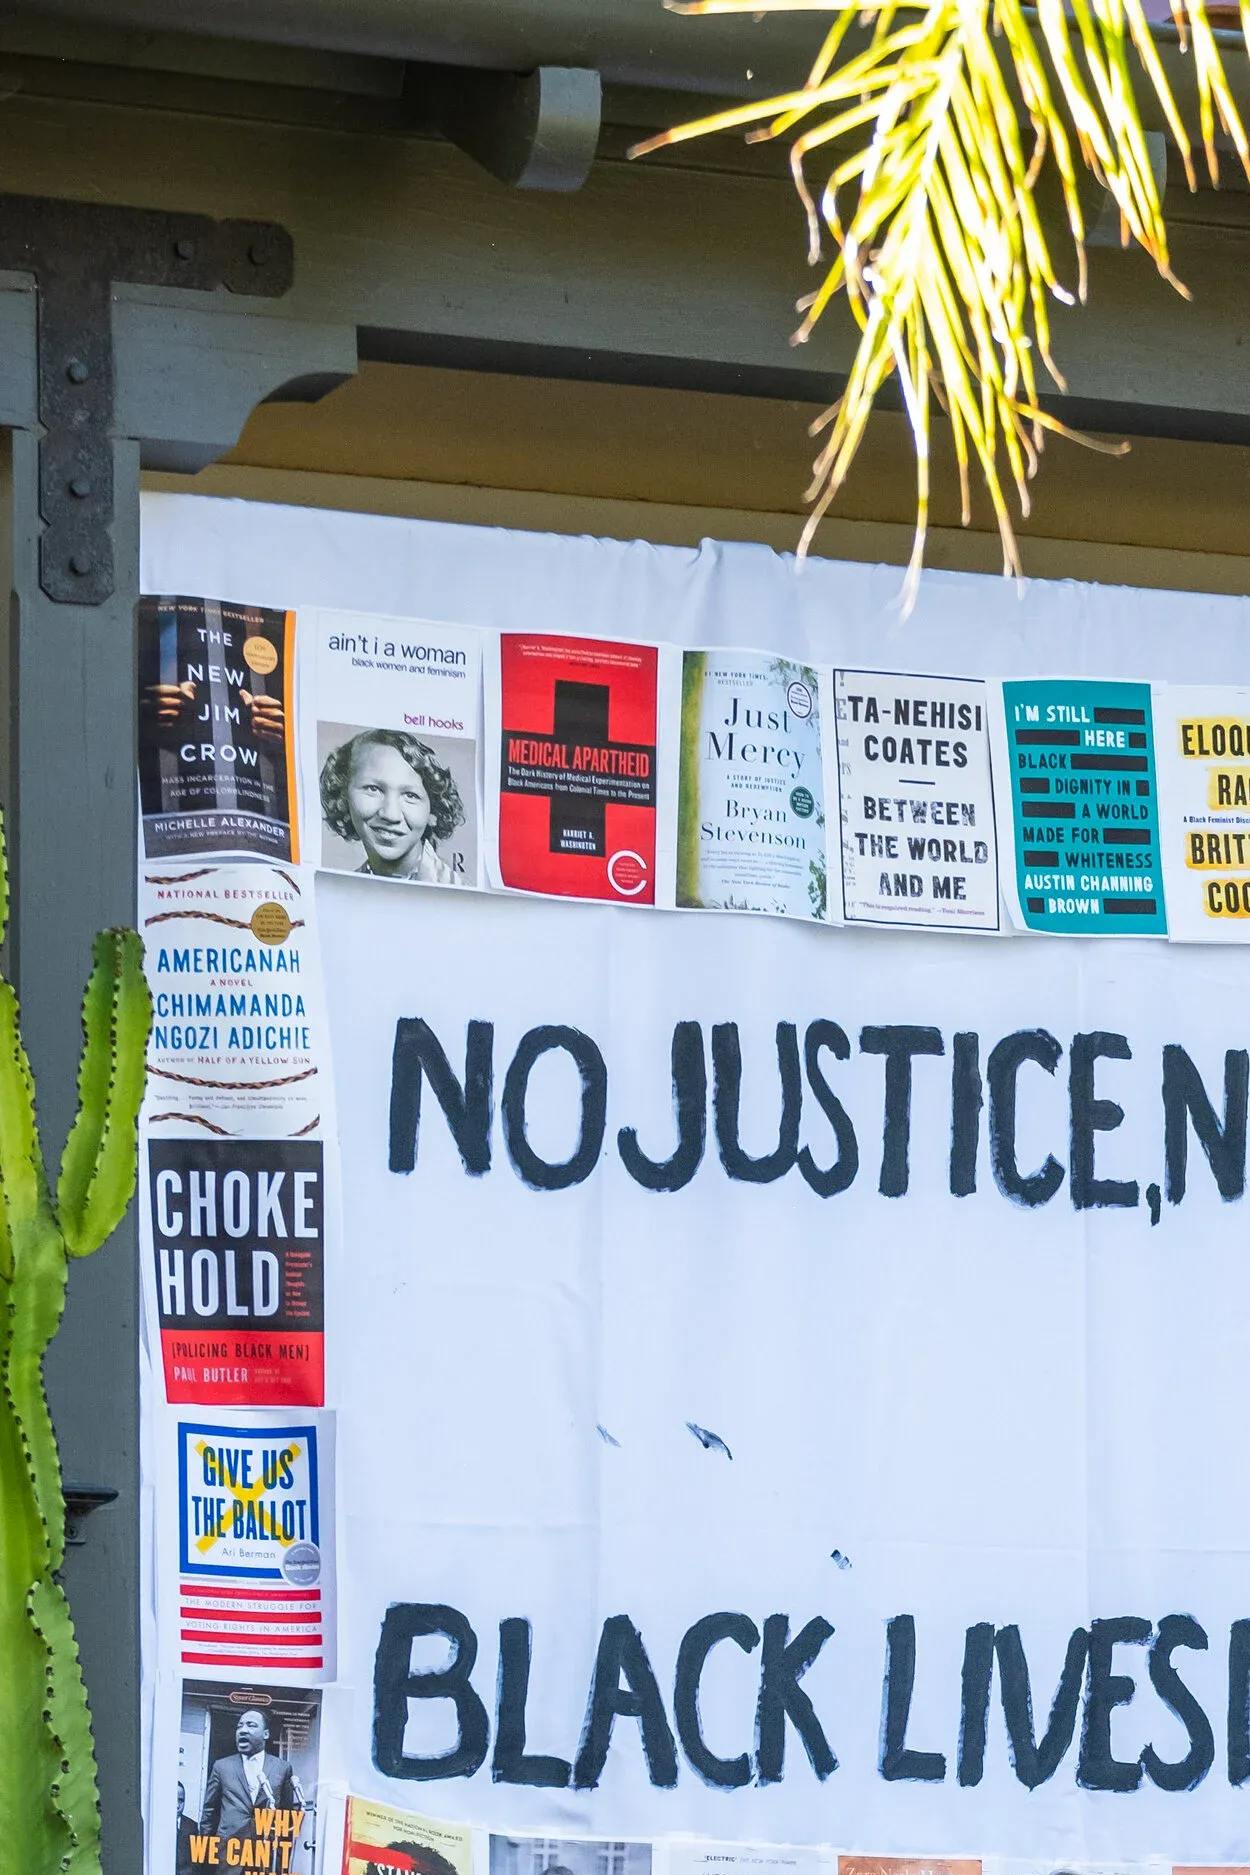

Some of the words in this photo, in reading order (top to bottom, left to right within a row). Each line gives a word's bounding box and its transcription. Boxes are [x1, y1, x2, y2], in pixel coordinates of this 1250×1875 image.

[197, 628, 233, 646] THE
[329, 633, 368, 654] ain't
[374, 637, 378, 655] i
[384, 642, 395, 657] a
[401, 643, 466, 665] woman
[187, 664, 244, 687] NEW
[352, 657, 374, 669] black
[376, 661, 407, 672] women
[409, 664, 425, 674] and
[427, 665, 466, 679] feminism
[198, 703, 240, 725] JIM
[404, 713, 425, 726] bell
[428, 716, 464, 730] hooks
[724, 698, 792, 733] Just
[848, 695, 981, 731] TA-NEHISI
[1015, 704, 1039, 722] I'M
[1046, 705, 1090, 723] STILL
[864, 734, 968, 768] COATES
[1084, 730, 1125, 748] HERE
[180, 744, 257, 767] CROW
[508, 738, 569, 769] MEDICAL
[573, 746, 649, 778] APARTHEID
[705, 731, 805, 779] Mercy
[1018, 753, 1067, 769] BLACK
[1055, 778, 1112, 795] DIGNITY
[1117, 780, 1131, 796] IN
[726, 799, 787, 825] Bryan
[863, 795, 976, 826] BETWEEN
[1082, 803, 1091, 819] A
[1096, 803, 1148, 820] WORLD
[700, 822, 806, 850] Stevenson
[854, 832, 899, 859] THE
[907, 837, 988, 864] WORLD
[1023, 827, 1065, 844] MADE
[1072, 827, 1100, 844] FOR
[1065, 852, 1153, 869] WHITENESS
[158, 889, 219, 899] NATIONAL
[225, 889, 294, 901] BESTSELLER
[879, 872, 923, 897] AND
[932, 876, 967, 900] ME
[1025, 873, 1075, 891] AUSTIN
[1080, 875, 1153, 892] CHANNING
[1048, 897, 1100, 914] BROWN
[157, 948, 300, 973] AMERICANAH
[156, 994, 306, 1018] CHIMAMANDA
[155, 1025, 218, 1050] NGOZI
[228, 1026, 312, 1050] ADICHIE
[388, 1017, 608, 1191] NO
[617, 1018, 1161, 1225] JUSTICE,
[156, 1169, 319, 1238] CHOKE
[159, 1249, 280, 1317] HOLD
[172, 1343, 228, 1359] [POLICING
[235, 1344, 272, 1358] BLACK
[279, 1344, 309, 1361] MEN]
[203, 1446, 253, 1489] GIVE
[262, 1448, 294, 1490] US
[192, 1496, 226, 1538] THE
[233, 1499, 307, 1541] BALLOT
[371, 1601, 839, 1791] BLACK
[876, 1612, 1215, 1793] LIVES
[254, 1808, 305, 1838] WHY
[189, 1835, 220, 1864] WE
[226, 1837, 292, 1868] CAN'T
